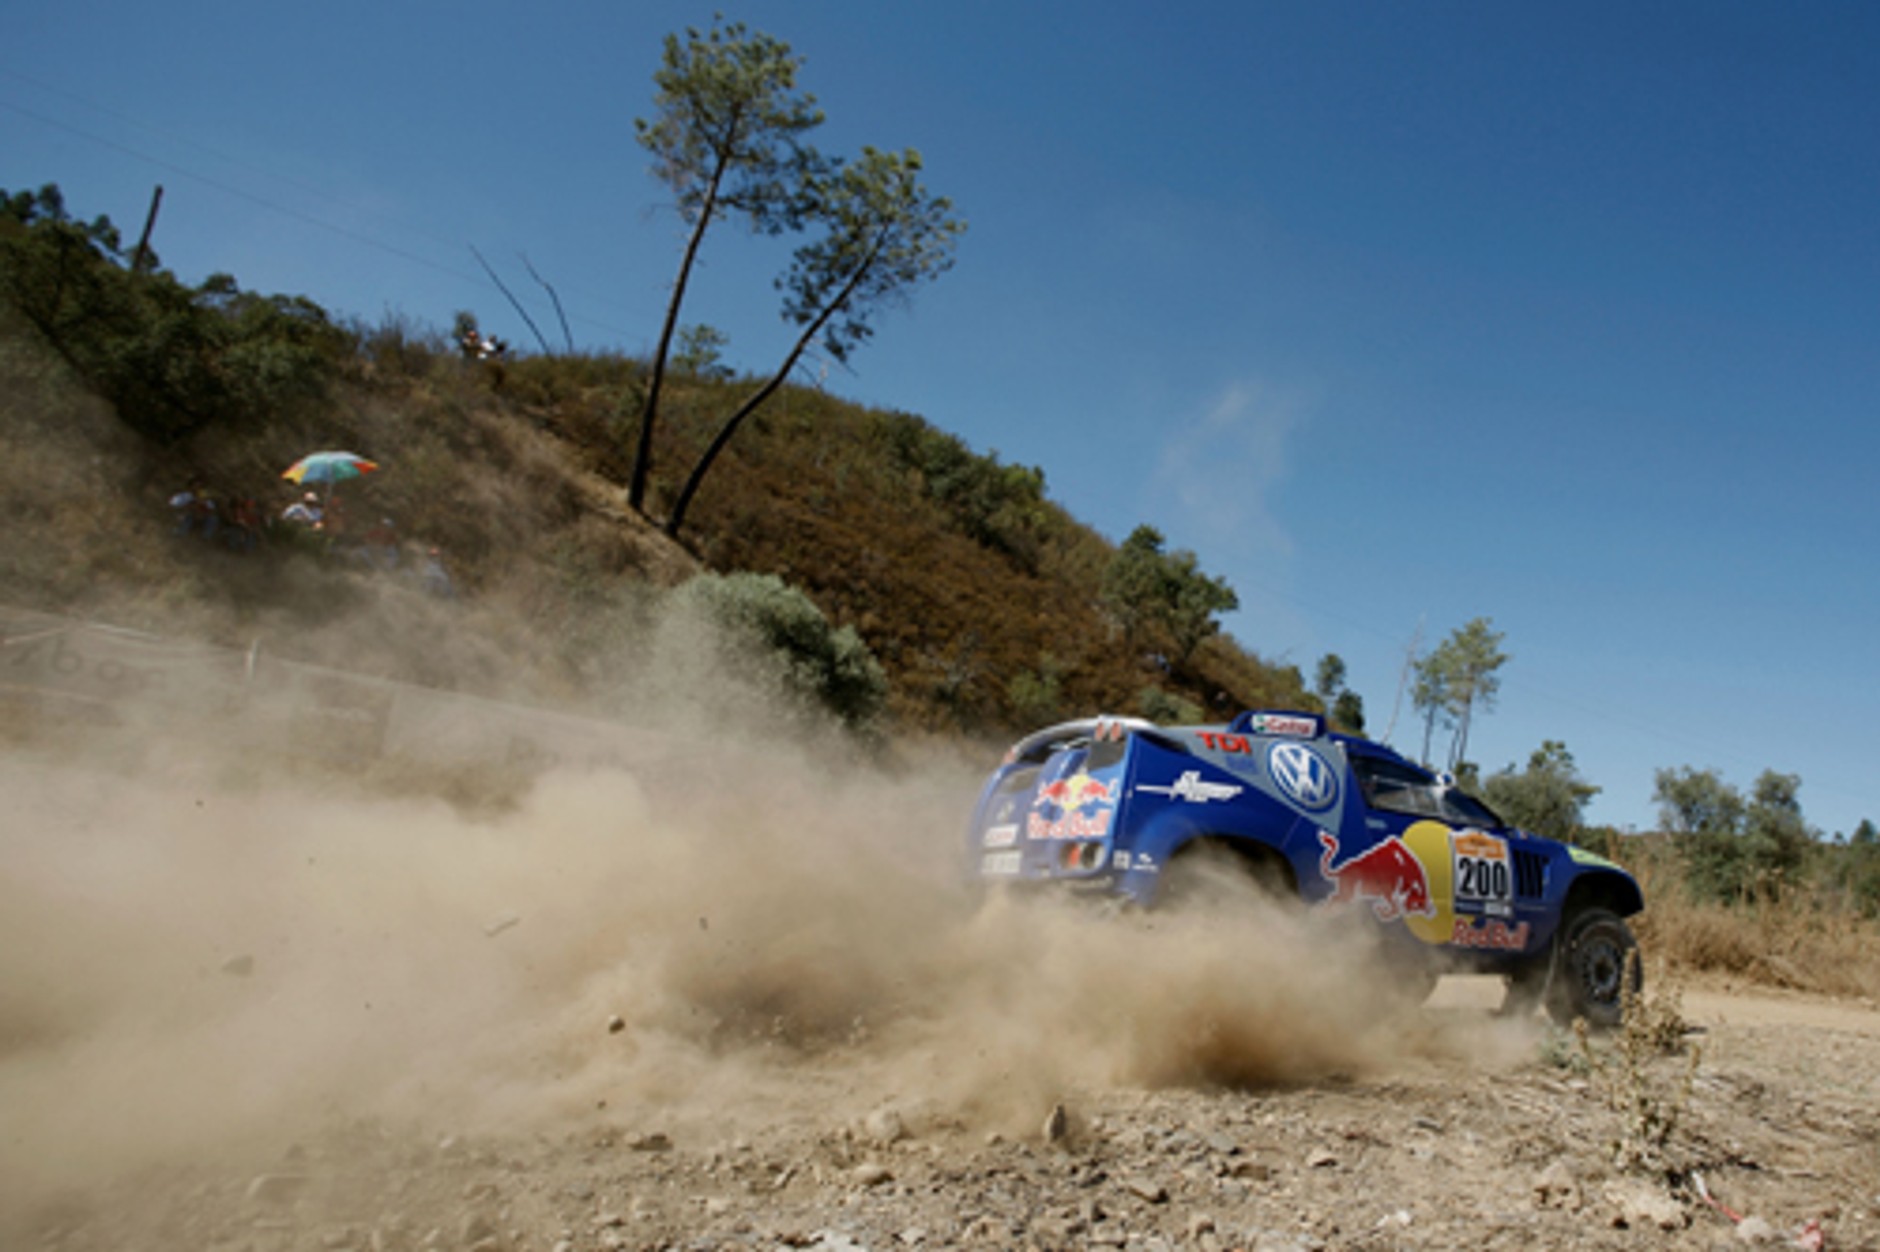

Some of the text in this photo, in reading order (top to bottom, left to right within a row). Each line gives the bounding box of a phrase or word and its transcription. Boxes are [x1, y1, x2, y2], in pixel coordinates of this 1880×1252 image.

[1195, 730, 1251, 754] TDI
[1028, 812, 1066, 840] Red
[1459, 857, 1508, 897] 200
[1453, 918, 1530, 949] Red Bull
